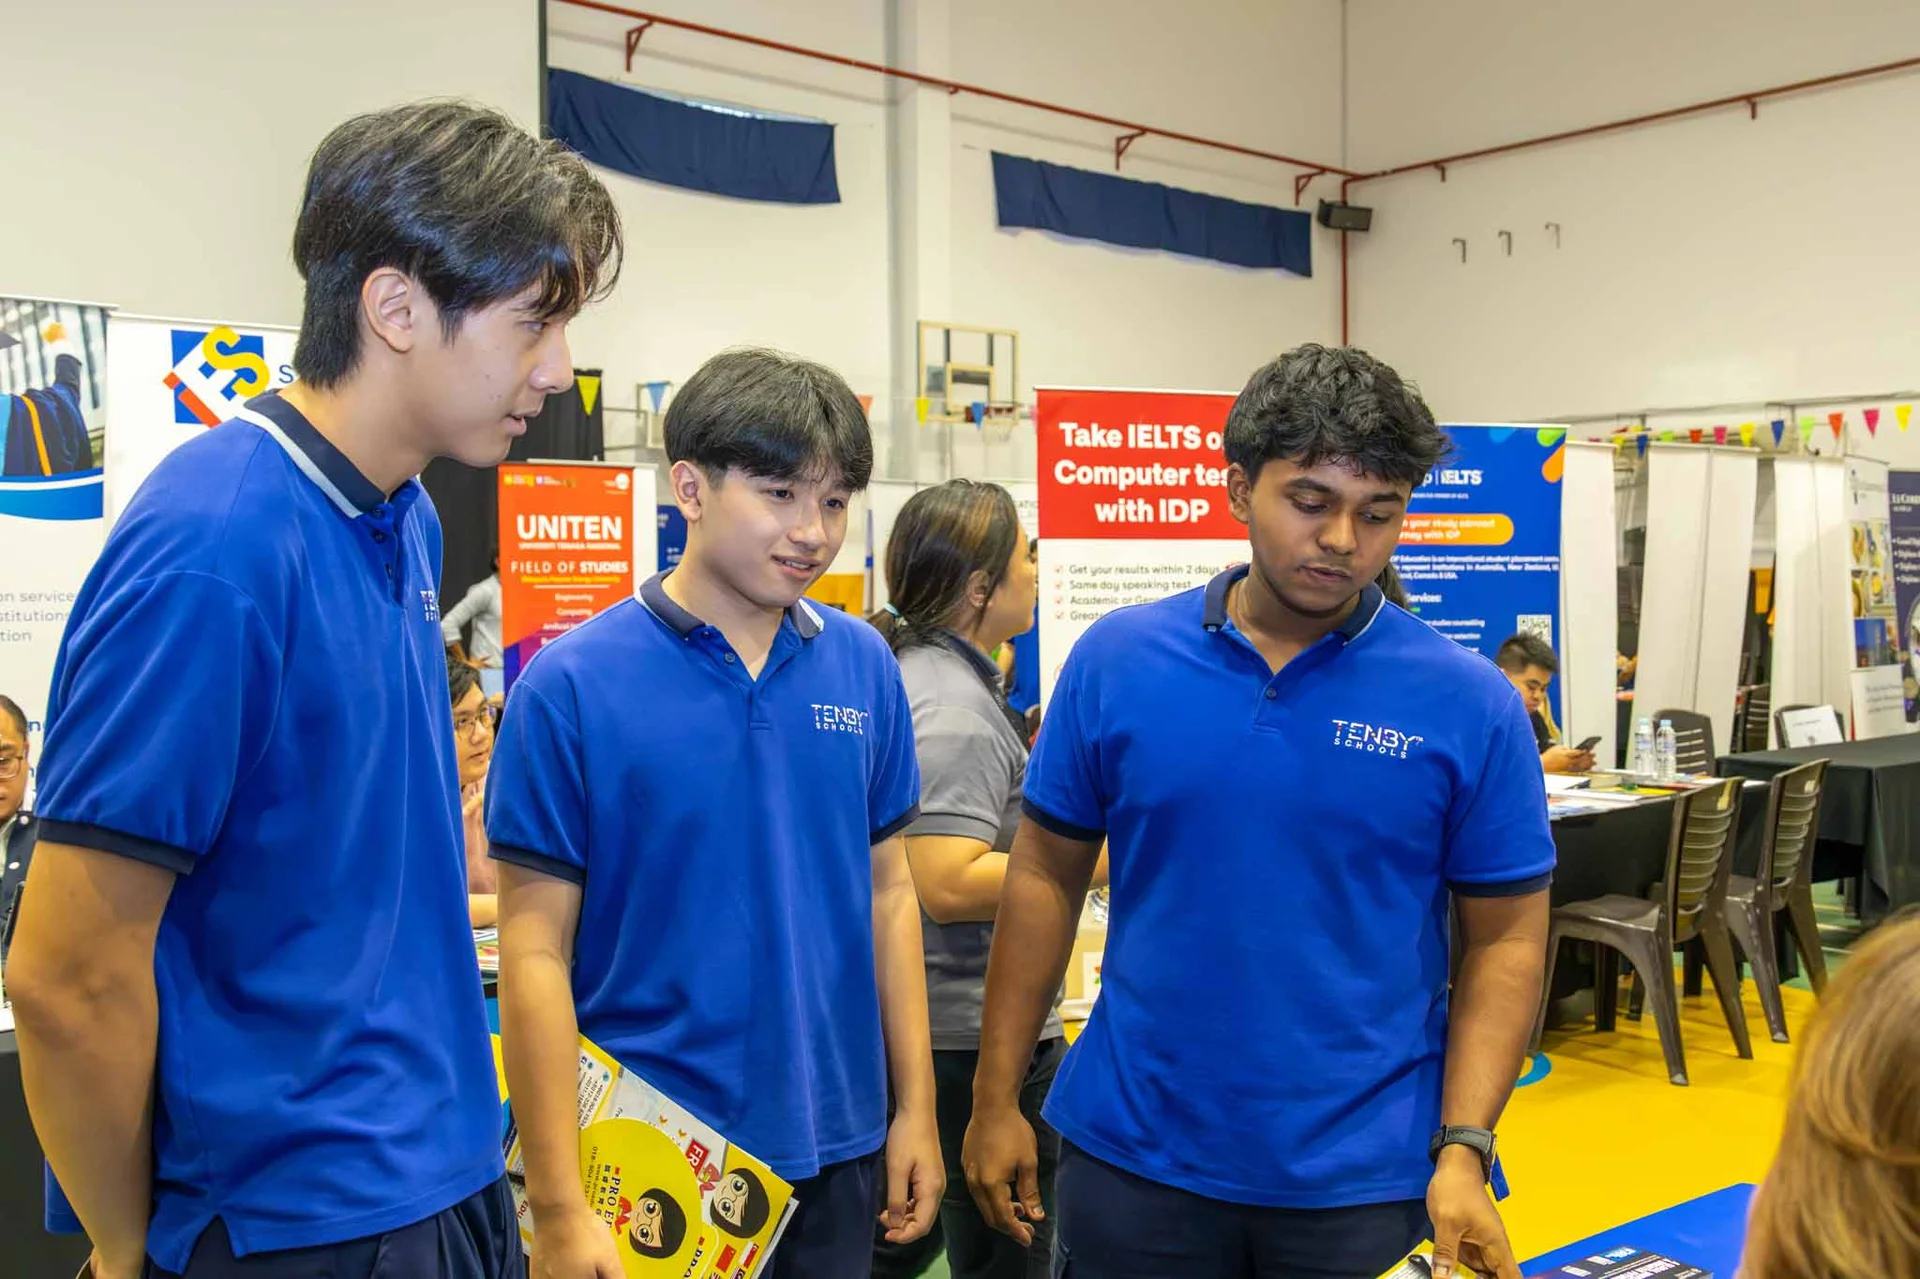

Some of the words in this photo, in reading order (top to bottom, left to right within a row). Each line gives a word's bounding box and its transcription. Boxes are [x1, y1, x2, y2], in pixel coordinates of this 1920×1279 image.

[1059, 422, 1123, 448] Take
[1128, 423, 1201, 450] IELTS
[1206, 431, 1225, 450] o
[1054, 459, 1191, 490] Computer
[1441, 469, 1483, 486] IELTS
[1095, 498, 1154, 522] with
[1159, 498, 1210, 523] IDP
[516, 513, 623, 541] UNITEN
[511, 560, 552, 574] FIELD
[557, 560, 575, 574] OF
[579, 560, 629, 574] STUDIES
[1069, 564, 1088, 575] Get
[1091, 566, 1112, 577] your
[1114, 564, 1150, 575] results
[1152, 564, 1184, 575] within
[1186, 564, 1193, 575] 2
[1195, 564, 1220, 576] days
[1069, 580, 1098, 590] Same
[1100, 580, 1120, 591] day
[1122, 579, 1169, 591] speaking
[1171, 580, 1191, 590] test
[1070, 595, 1119, 605] Academic
[811, 704, 868, 727] TENBY
[815, 721, 863, 735] SCHOOLS
[1332, 719, 1415, 751] TENBY
[1334, 737, 1407, 759] SCHOOLS
[606, 1176, 621, 1207] PRO
